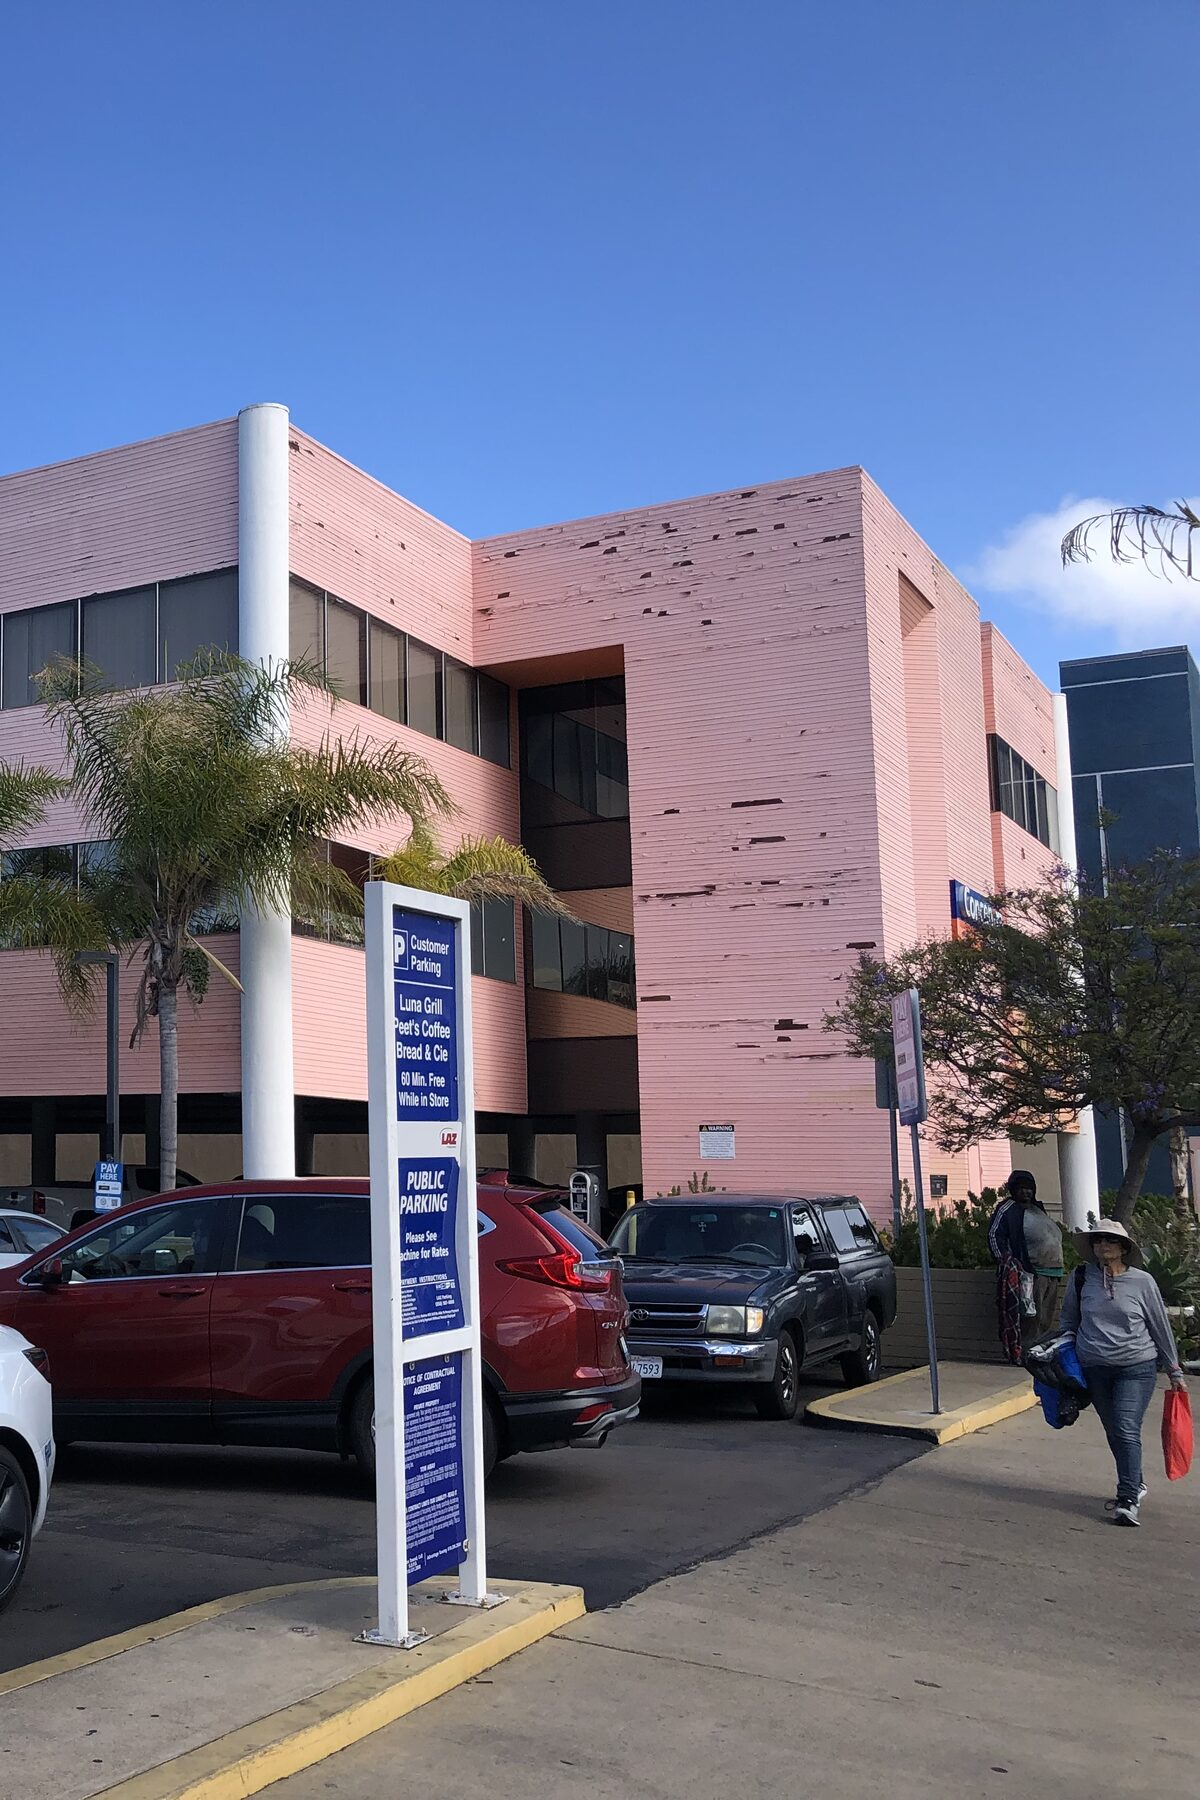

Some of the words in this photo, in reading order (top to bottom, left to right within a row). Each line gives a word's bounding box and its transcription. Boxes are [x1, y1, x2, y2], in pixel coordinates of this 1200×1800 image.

[411, 934, 449, 955] Customer
[411, 955, 441, 978] Parking
[400, 994, 422, 1013] Luna
[424, 997, 443, 1015] Grill
[394, 1017, 419, 1036] Peet's
[421, 1020, 450, 1039] Coffee
[397, 1041, 422, 1060] Bread
[425, 1044, 431, 1061] &
[434, 1044, 448, 1062] Cie
[401, 1071, 410, 1087] 60
[412, 1072, 427, 1087] Min.
[429, 1073, 445, 1088] Free
[399, 1092, 419, 1106] While
[421, 1092, 428, 1106] in
[429, 1092, 449, 1107] Store
[708, 1124, 732, 1132] WARNING
[441, 1133, 457, 1145] LAZ
[100, 1163, 118, 1173] PAY
[407, 1170, 445, 1190] PUBLIC
[400, 1193, 448, 1215] PARKING
[405, 1232, 424, 1244] Please
[426, 1230, 437, 1241] See
[400, 1249, 419, 1261] achine
[421, 1247, 430, 1259] for
[432, 1246, 449, 1257] Rates
[419, 1273, 448, 1282] INSTRUCTIONS
[403, 1375, 416, 1385] OTICE
[416, 1373, 423, 1383] OF
[424, 1366, 456, 1381] CONTRACTUAL
[413, 1381, 441, 1396] AGREEMENT
